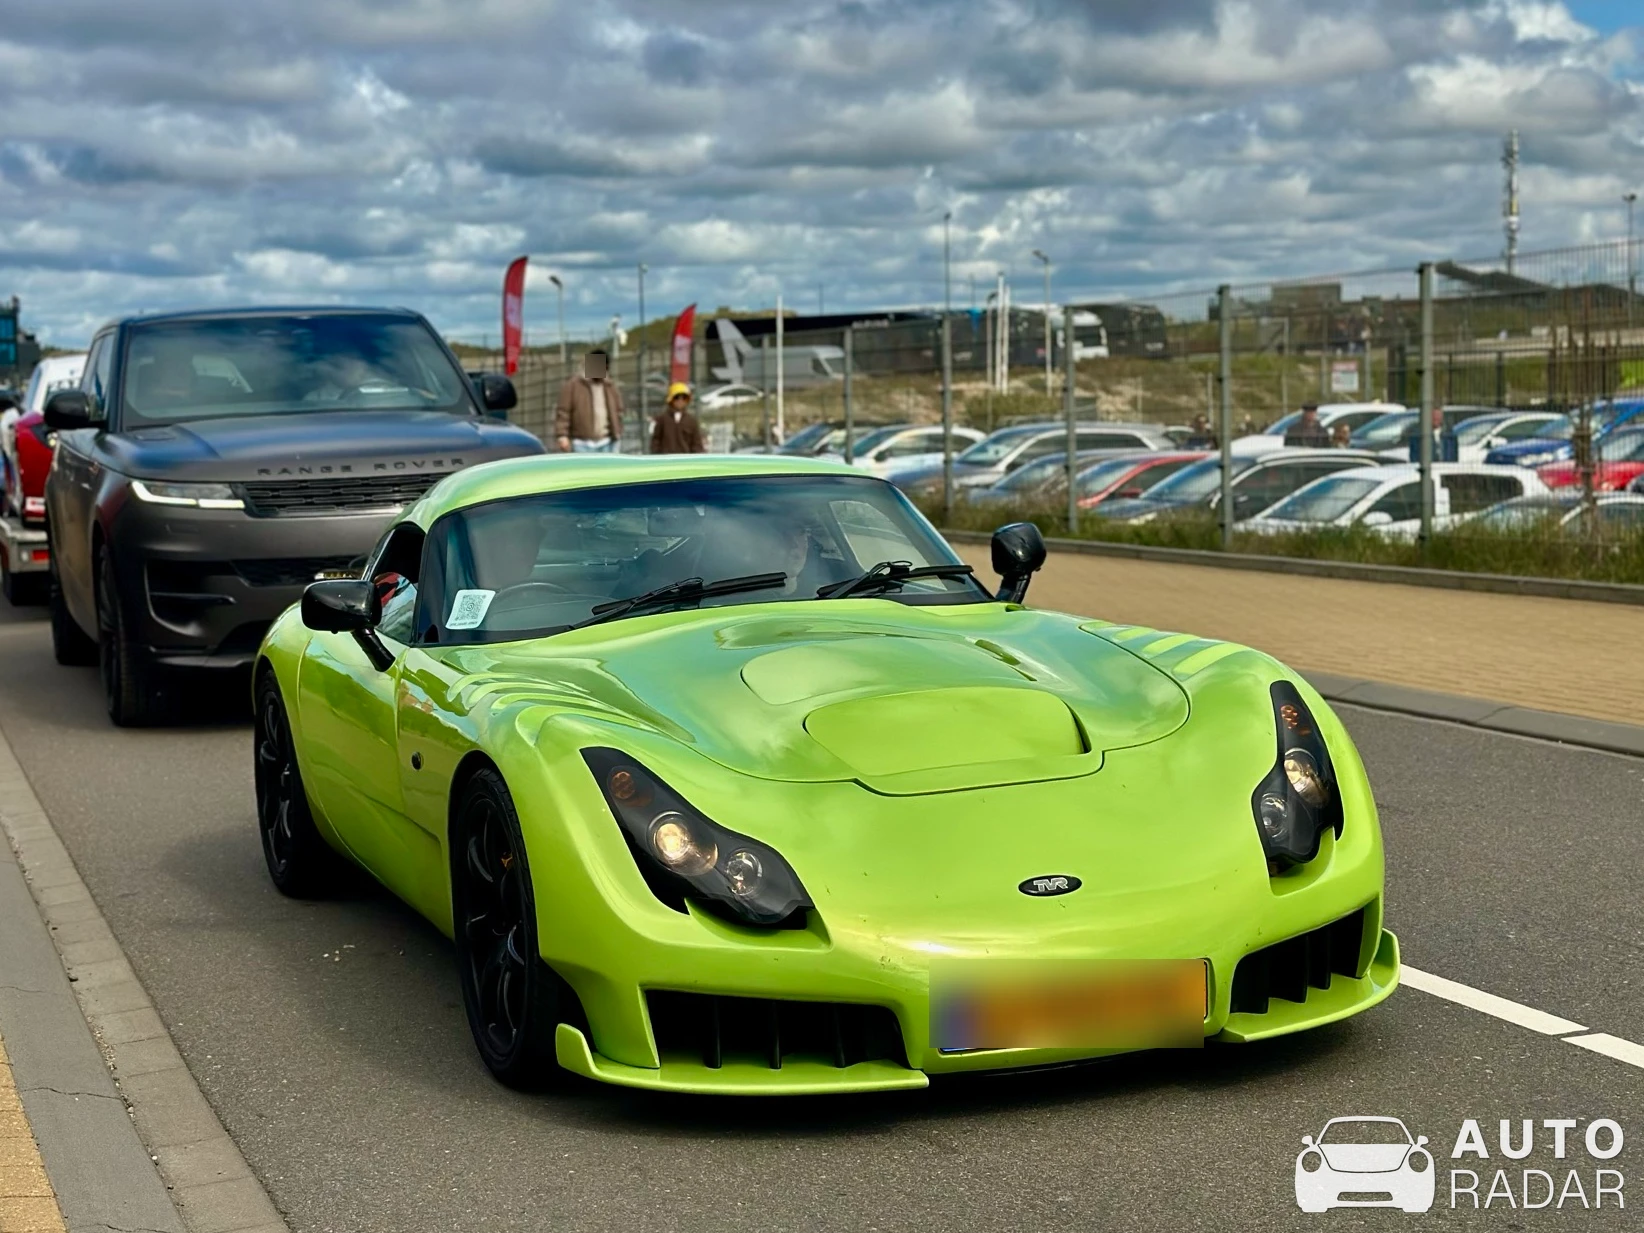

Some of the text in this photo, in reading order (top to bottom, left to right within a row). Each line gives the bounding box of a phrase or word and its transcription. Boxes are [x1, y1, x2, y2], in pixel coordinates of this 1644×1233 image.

[257, 457, 465, 476] RANGE ROVER
[1033, 877, 1069, 892] TVR
